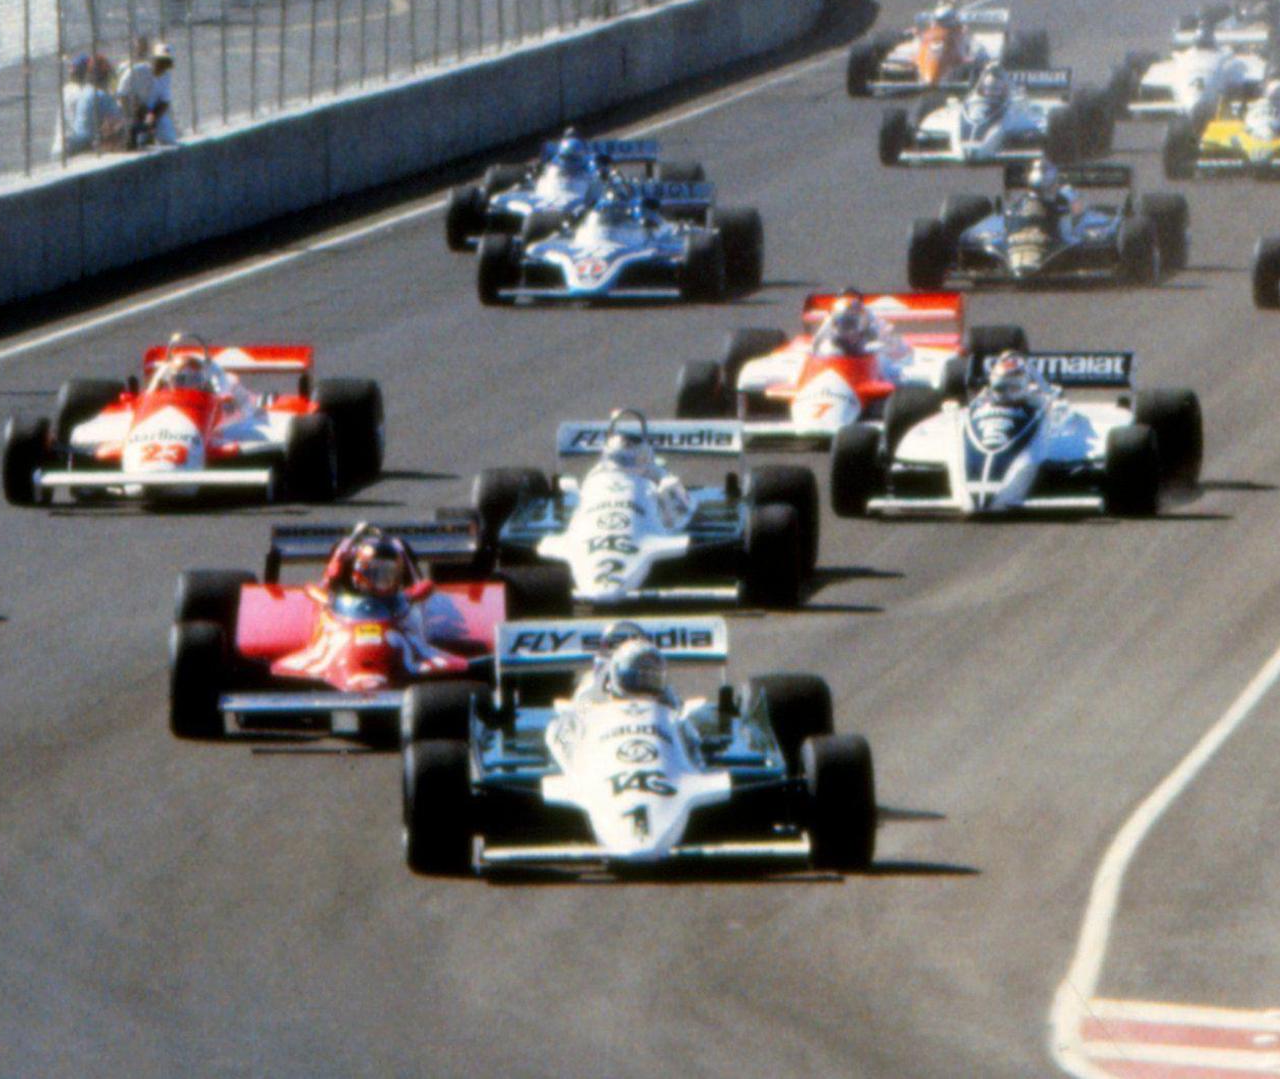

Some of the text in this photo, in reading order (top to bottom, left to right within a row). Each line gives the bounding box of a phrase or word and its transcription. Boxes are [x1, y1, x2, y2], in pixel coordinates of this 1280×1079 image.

[142, 441, 189, 466] 23
[593, 557, 625, 589] 2
[510, 629, 577, 655] FLY
[607, 769, 678, 797] TAG
[623, 803, 651, 843] 1
